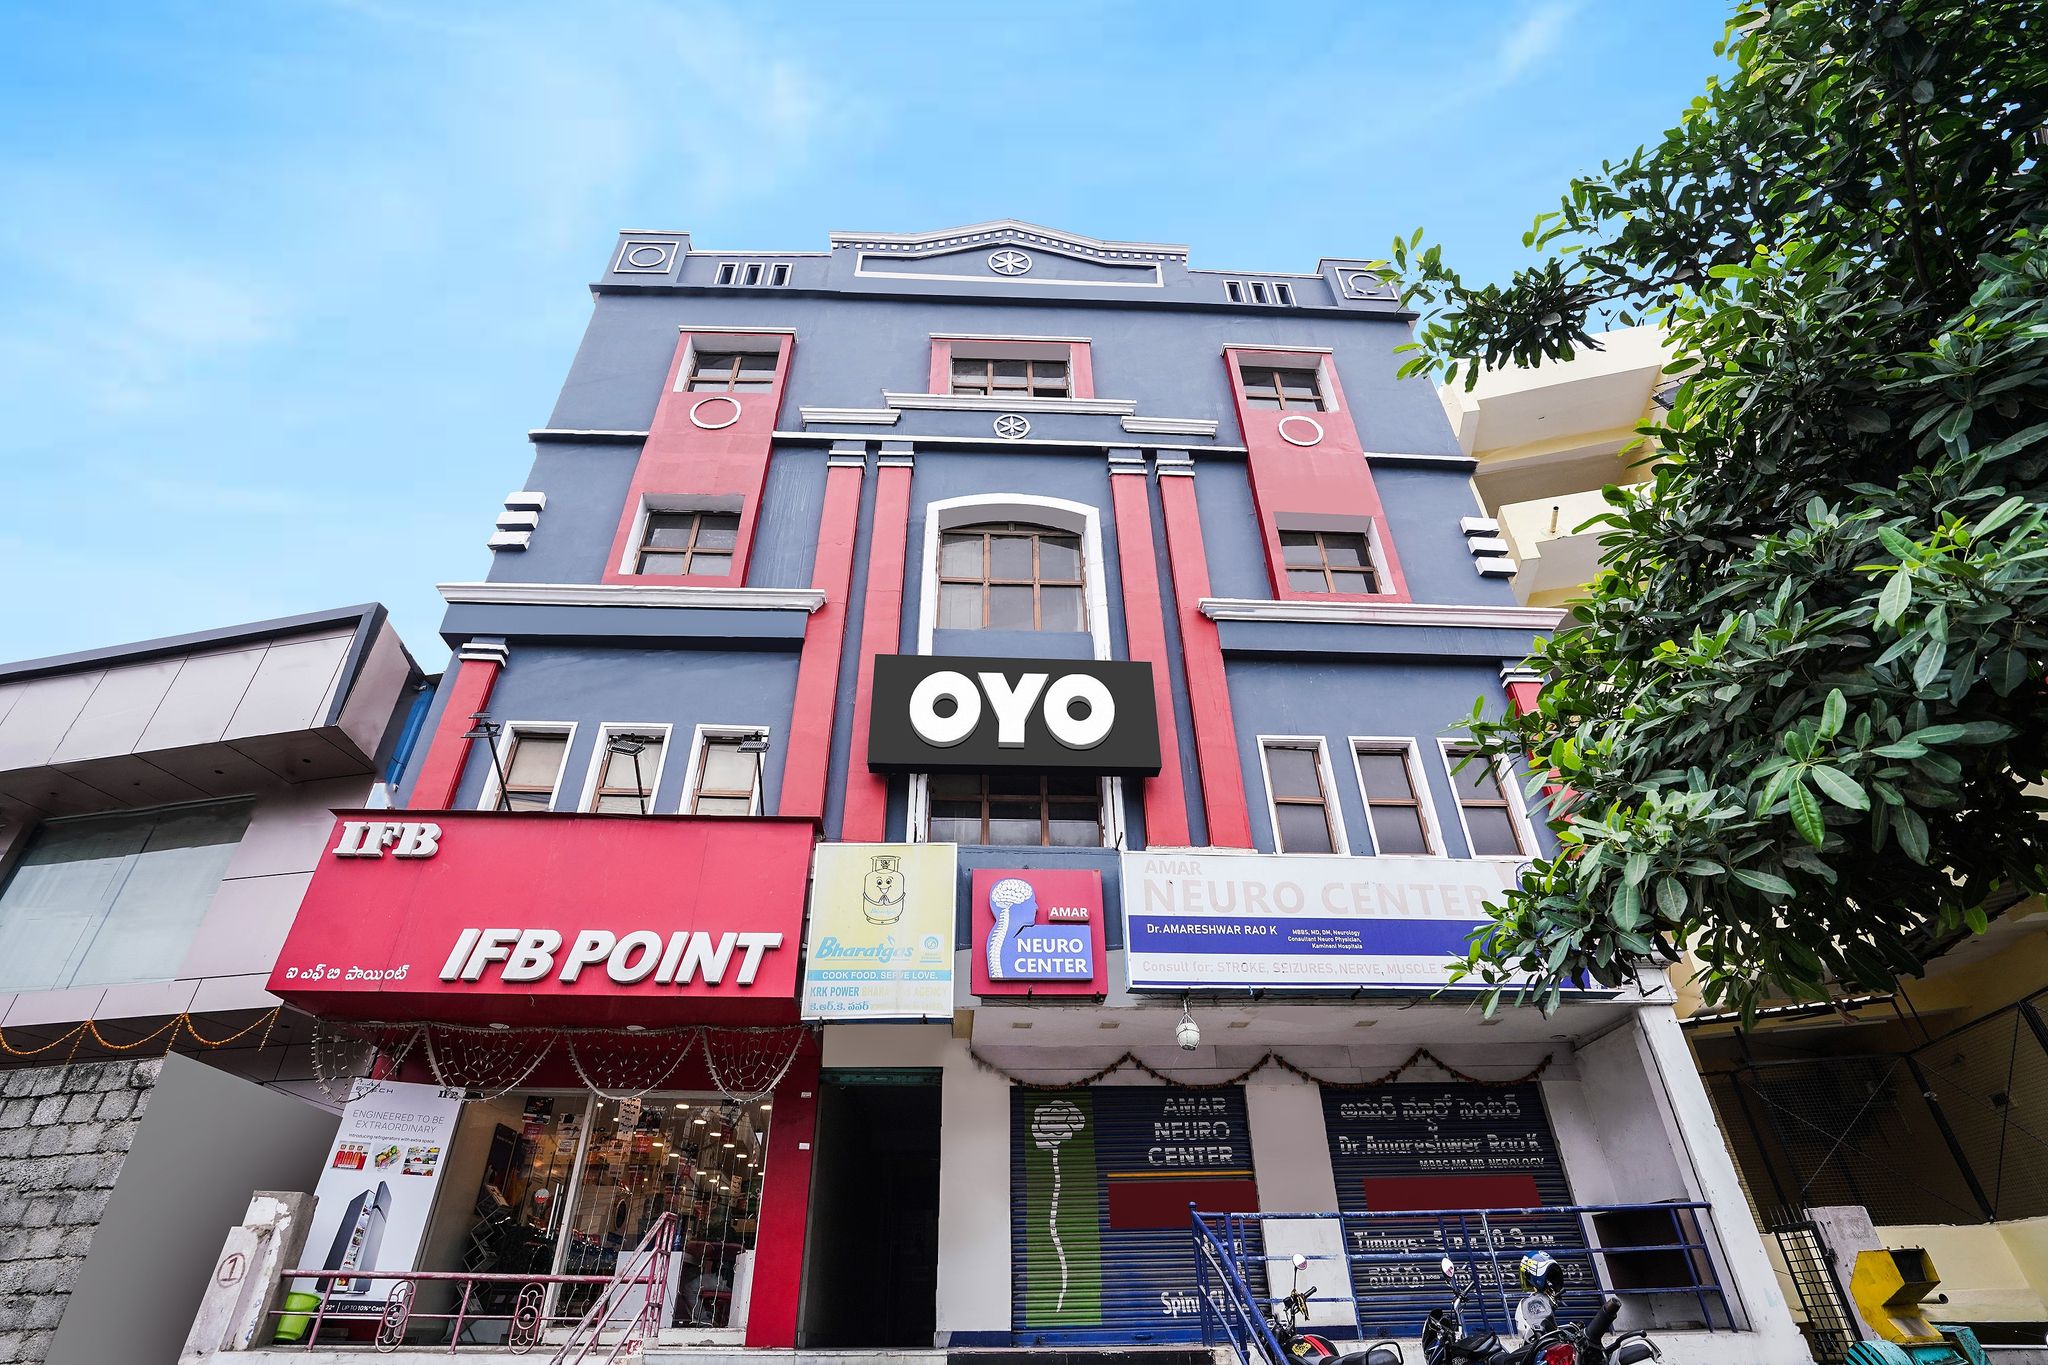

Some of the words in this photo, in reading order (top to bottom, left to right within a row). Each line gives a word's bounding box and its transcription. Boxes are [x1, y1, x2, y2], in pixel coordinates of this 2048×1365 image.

[909, 671, 1115, 750] OYO
[332, 821, 443, 857] IFB
[1144, 860, 1203, 876] AMAR
[1143, 879, 1305, 914] NEURO
[1321, 882, 1489, 917] CENTER
[1050, 906, 1088, 917] AMAR
[1244, 925, 1267, 936] RAO
[1269, 925, 1278, 936] K
[1017, 938, 1084, 953] NEURO
[438, 928, 563, 982] IFB
[558, 930, 783, 985] POINT
[1014, 957, 1088, 973] CENTER
[1142, 960, 1190, 973] Consult
[1387, 963, 1437, 976] MUSCLE
[822, 971, 848, 980] COOK
[851, 971, 878, 980] FOOD.
[912, 971, 938, 980] LOVE.
[810, 986, 828, 997] KRK
[829, 986, 860, 997] POWER
[1163, 1097, 1228, 1116] AMAR
[352, 1109, 414, 1122] ENGINEERED
[417, 1114, 430, 1123] TO
[431, 1115, 445, 1125] BE
[355, 1120, 437, 1133] EXTRAORDINARY
[1154, 1121, 1231, 1142] NEURO
[1148, 1146, 1235, 1167] CENTER
[1161, 1291, 1204, 1318] Spin
